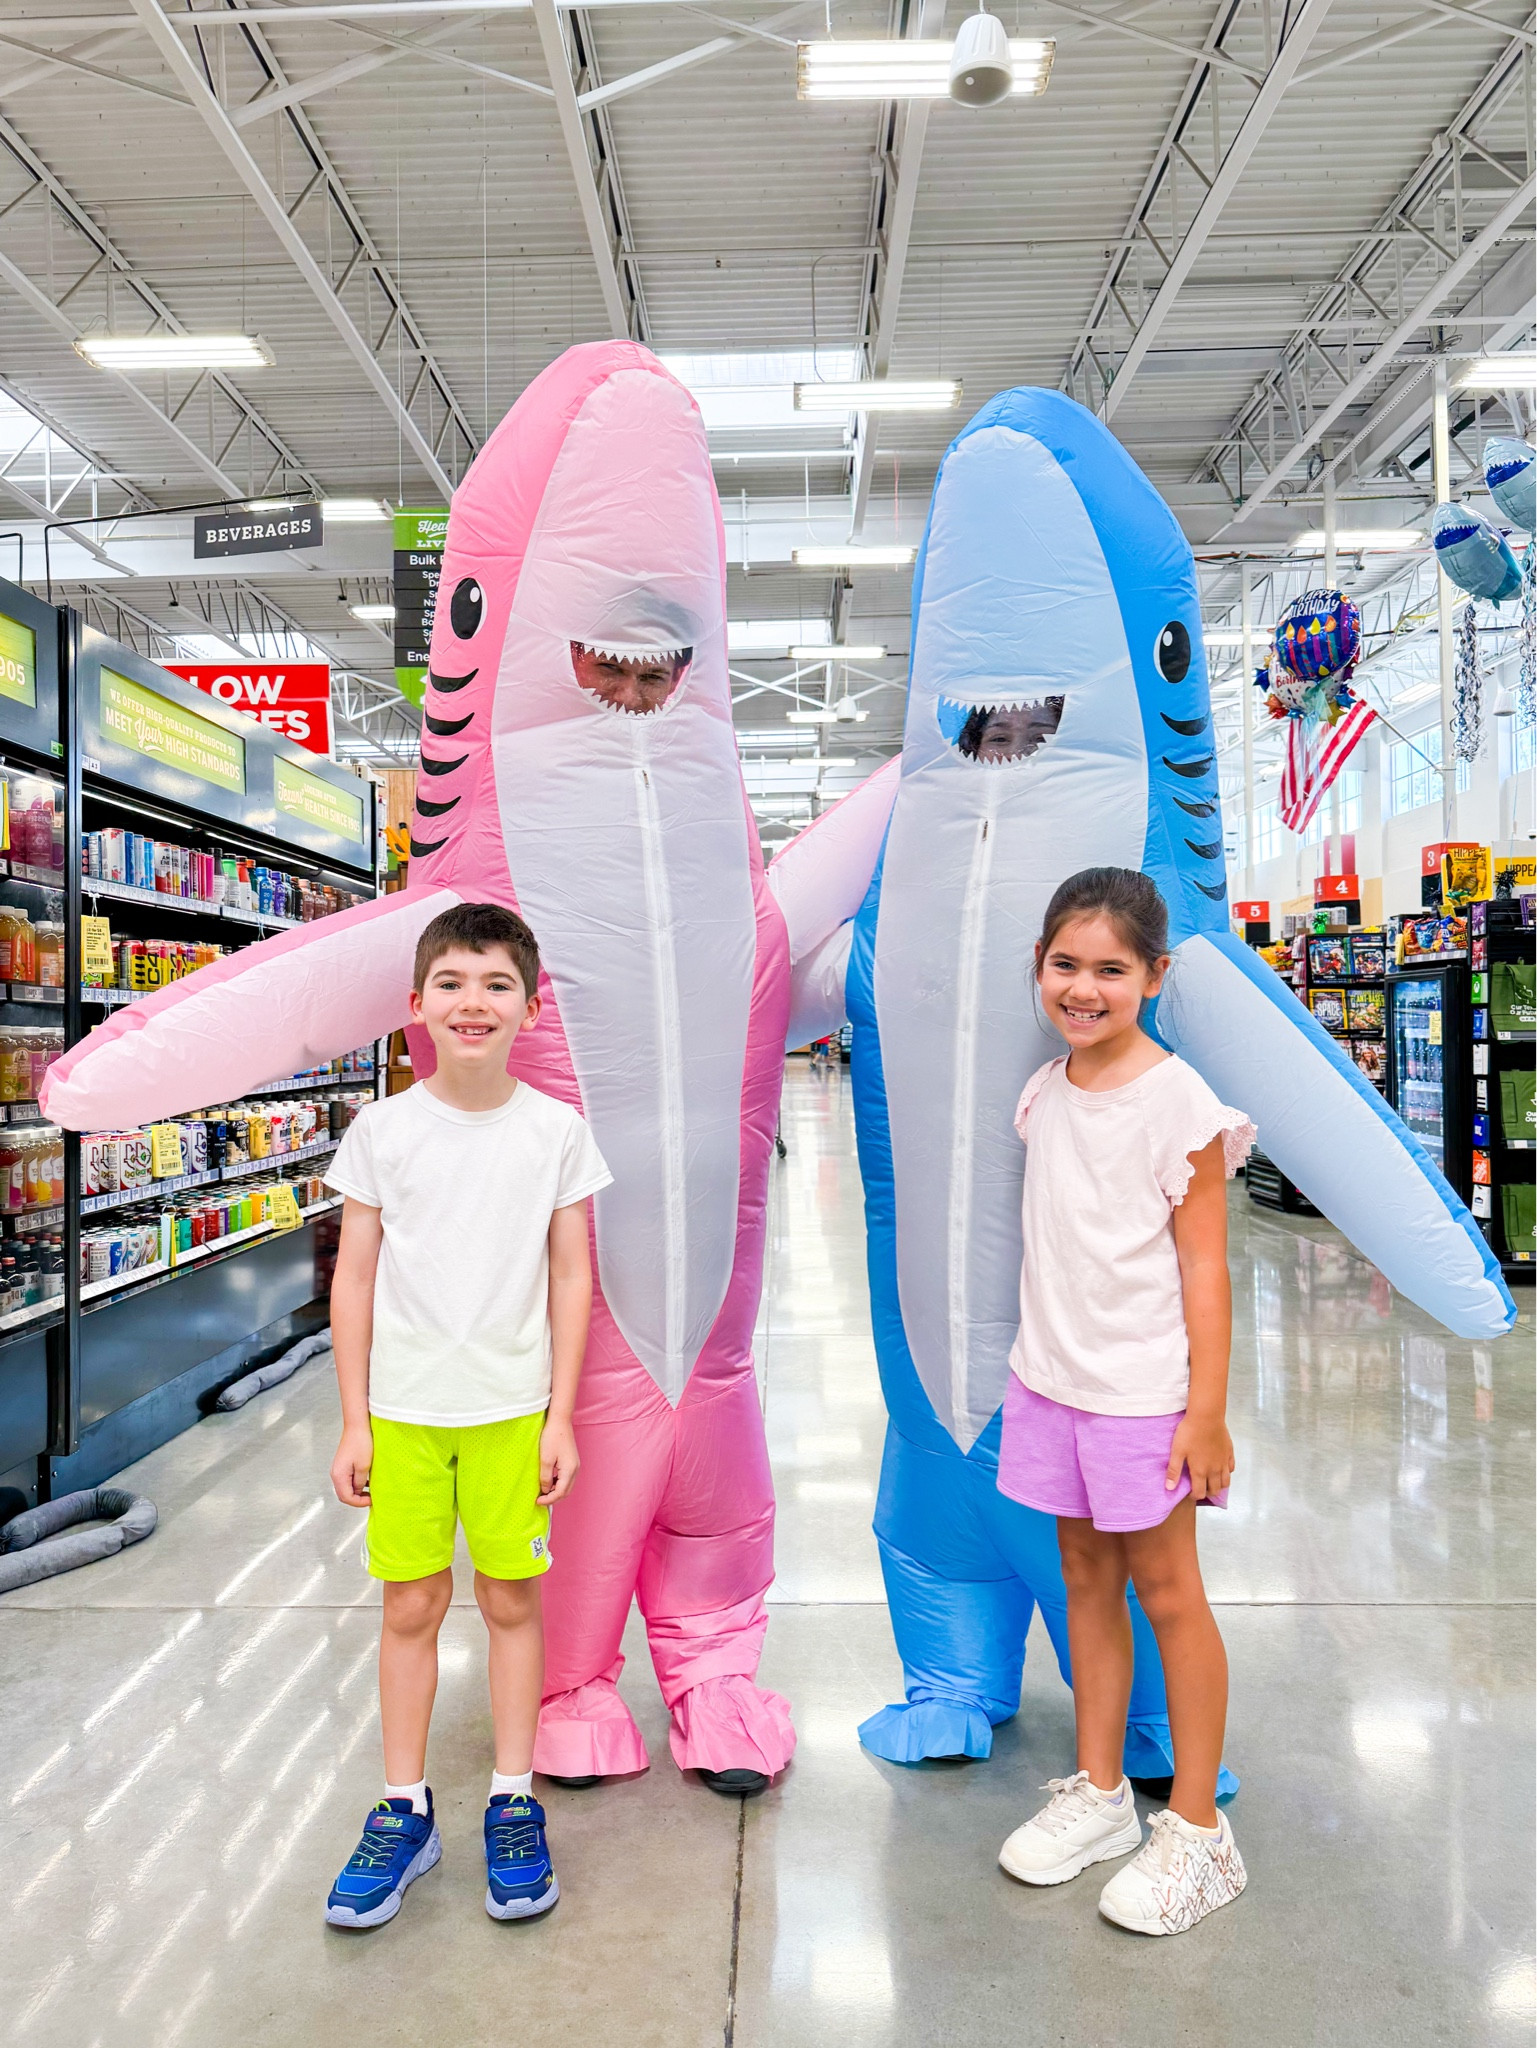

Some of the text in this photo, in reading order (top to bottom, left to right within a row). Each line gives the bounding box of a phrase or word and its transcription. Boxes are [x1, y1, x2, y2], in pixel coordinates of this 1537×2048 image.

[206, 519, 311, 543] BEVERAGES
[409, 554, 437, 566] Bulk
[110, 688, 121, 702] WE
[123, 695, 144, 716] OFFER
[146, 706, 193, 738] HIGH-QUALITY
[195, 732, 228, 753] PRODUCTS
[105, 707, 240, 781] MEET Your HIGH STANDARDS
[304, 797, 329, 820] HEALTH
[330, 809, 348, 828] SINCE
[1427, 851, 1435, 867] 3
[1335, 880, 1348, 893] 4
[1250, 905, 1261, 917] 5
[147, 953, 160, 985] C4
[1317, 1001, 1340, 1017] SPACE
